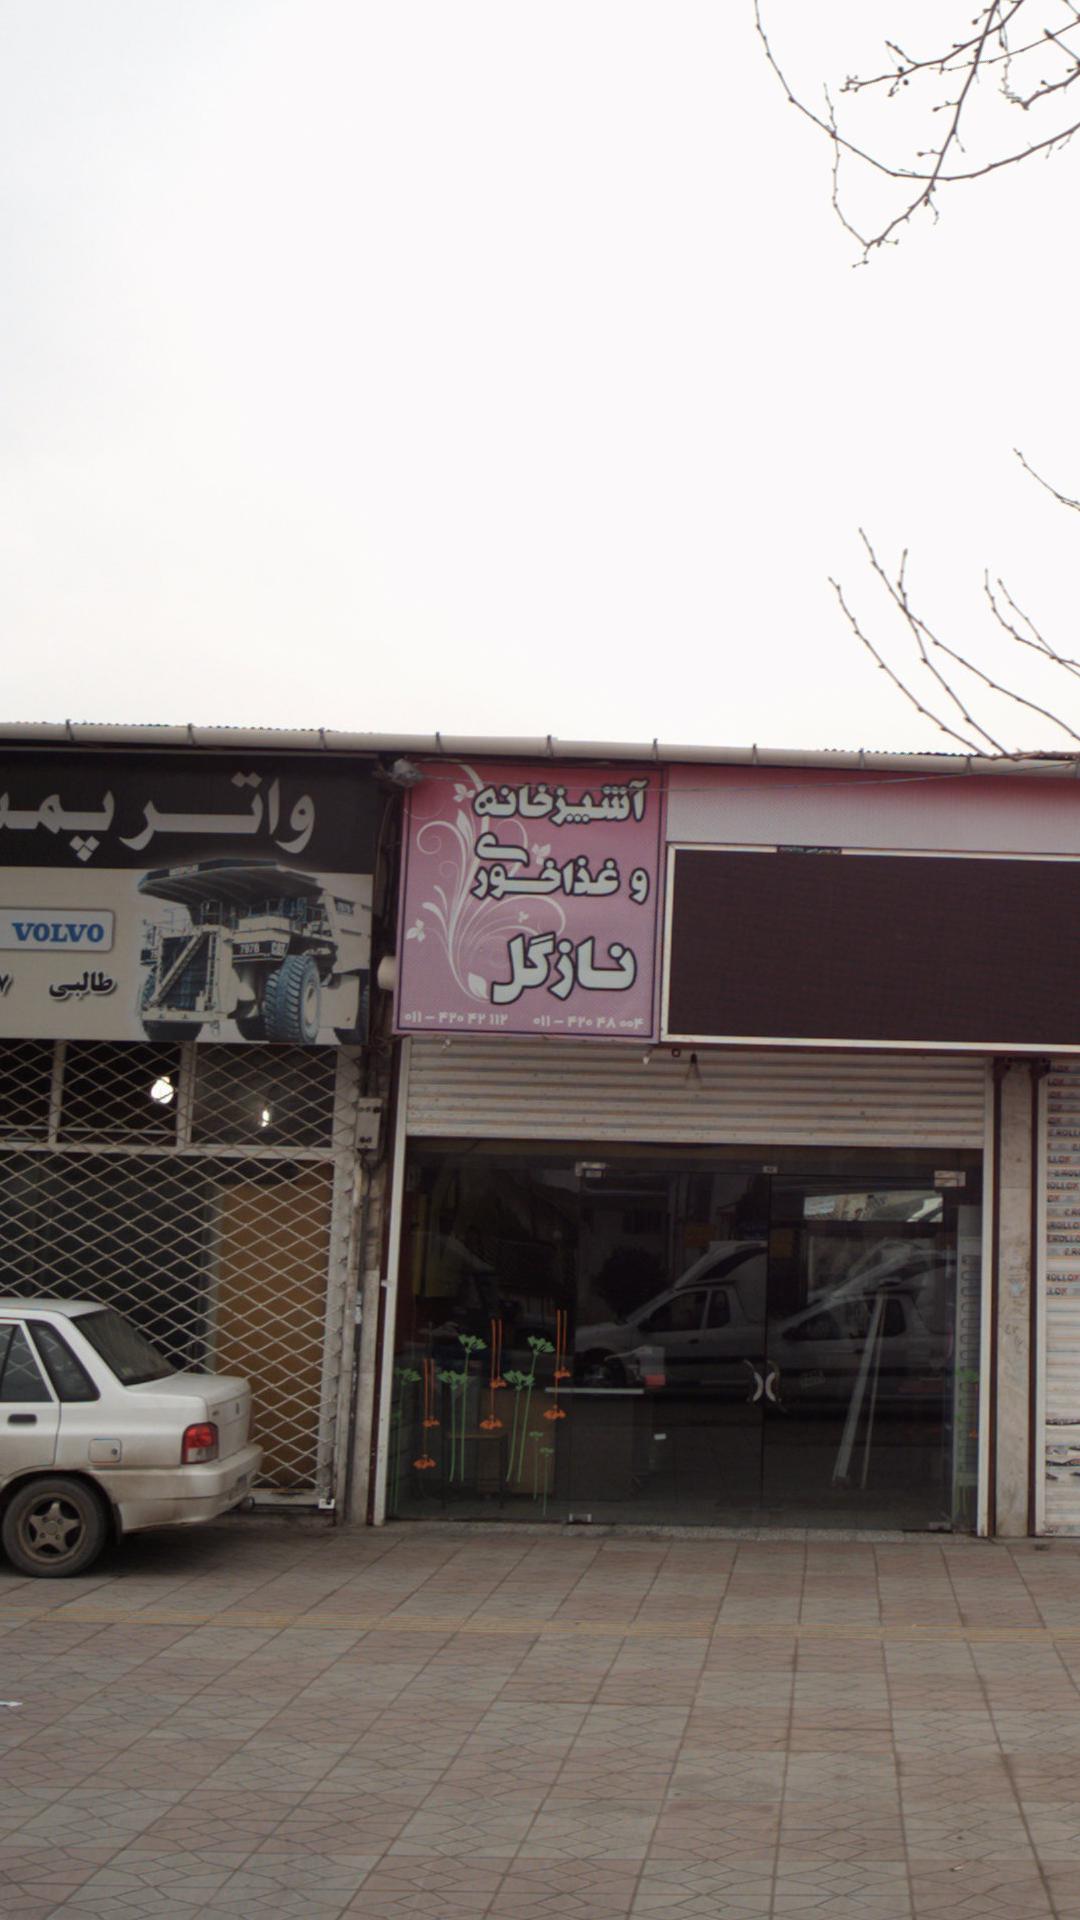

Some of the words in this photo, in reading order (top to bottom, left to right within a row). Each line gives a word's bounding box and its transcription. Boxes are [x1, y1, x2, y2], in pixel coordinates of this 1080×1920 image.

[0, 789, 116, 862] پم
[118, 771, 316, 854] واتر
[472, 777, 650, 827] آشپزخانه
[470, 832, 621, 900] غذاخوری
[629, 867, 650, 904] و
[11, 921, 105, 943] VOLVO
[48, 971, 115, 999] طالبی
